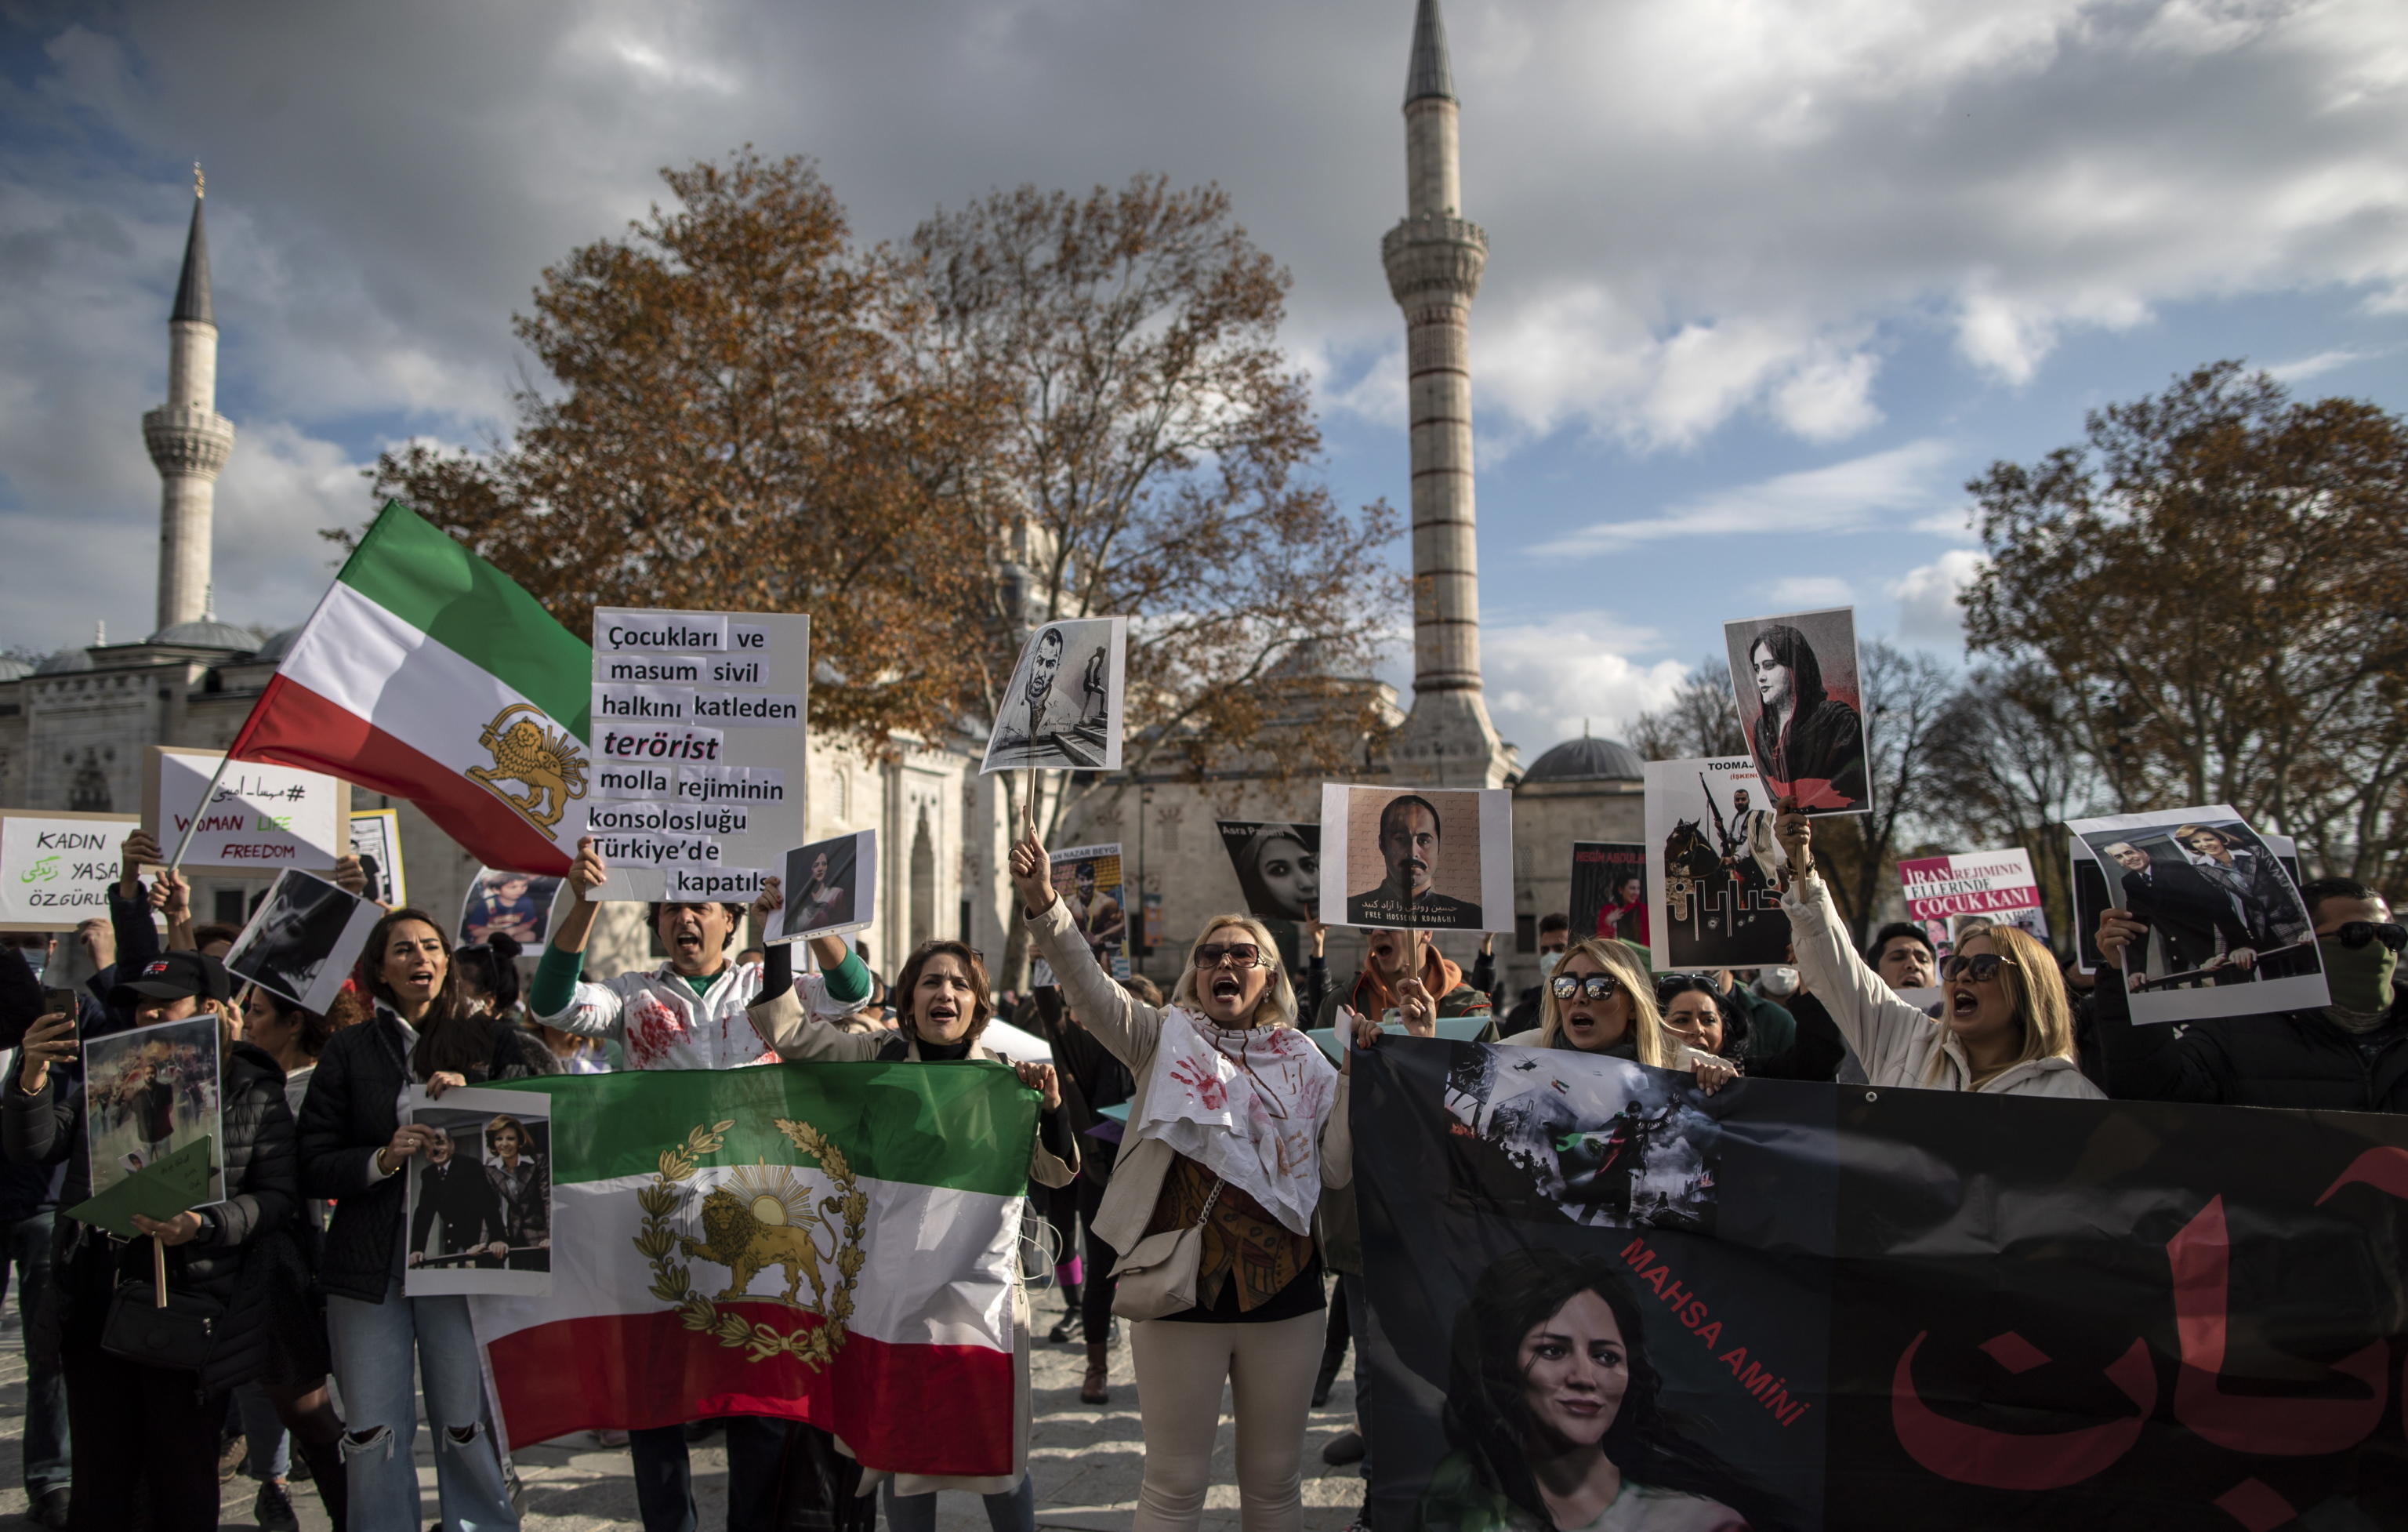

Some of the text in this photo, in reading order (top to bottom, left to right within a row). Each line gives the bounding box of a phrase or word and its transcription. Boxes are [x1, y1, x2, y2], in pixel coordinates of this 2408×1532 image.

[608, 626, 764, 649] Çocukları ve
[611, 662, 759, 682] masum sivil
[602, 693, 796, 718] halkını katleden
[604, 731, 719, 761] terörist
[600, 770, 783, 801] molla rejiminin
[174, 814, 292, 832] WOMAN LIFE
[589, 807, 746, 833] konsolosluğu
[1223, 826, 1246, 835] Asra
[36, 831, 107, 850] KADIN
[220, 844, 296, 859] FREEDOM
[1906, 866, 1952, 886] İRAN
[1914, 888, 2031, 920] ÇOCUK KANI
[1365, 911, 1382, 920] FREE
[1386, 913, 1417, 922] HOSSEIN
[1619, 1237, 1811, 1427] MAHSA AMİNİ
